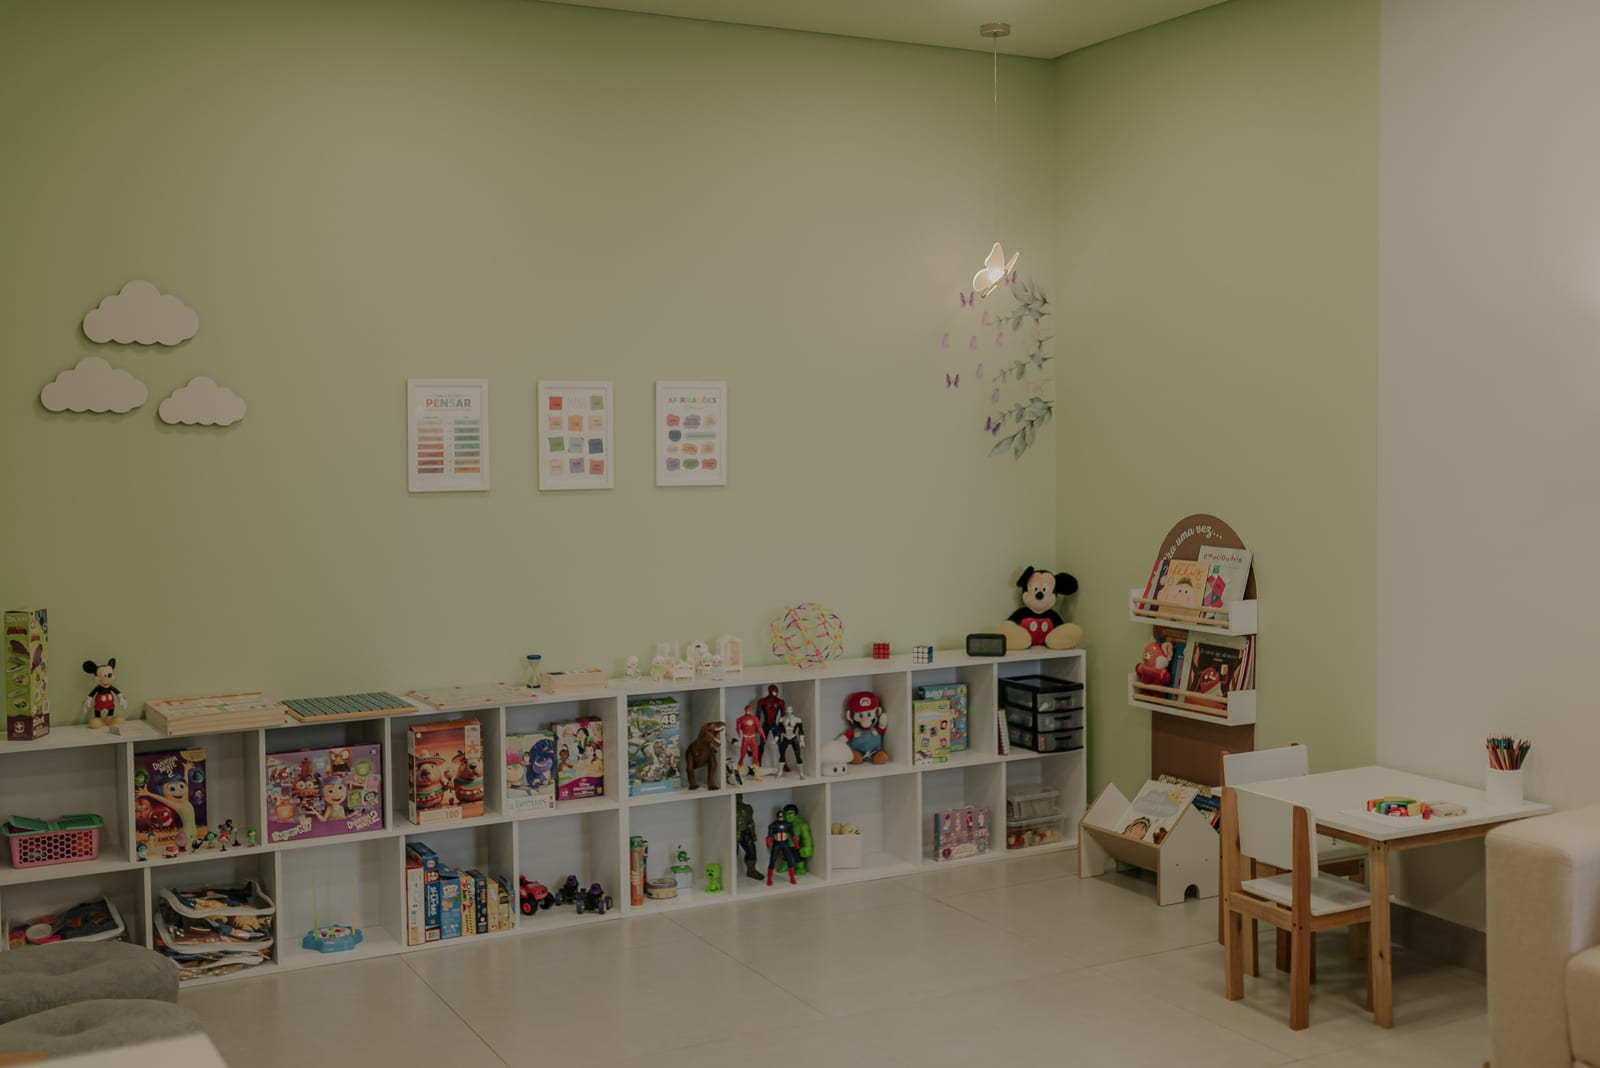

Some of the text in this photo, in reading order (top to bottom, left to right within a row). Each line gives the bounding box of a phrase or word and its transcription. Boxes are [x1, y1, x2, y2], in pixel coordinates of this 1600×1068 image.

[426, 398, 472, 408] PENSAR
[1176, 527, 1195, 546] uma
[661, 714, 677, 725] 48
[166, 769, 175, 779] 2
[368, 810, 380, 823] 2
[445, 810, 459, 820] 100
